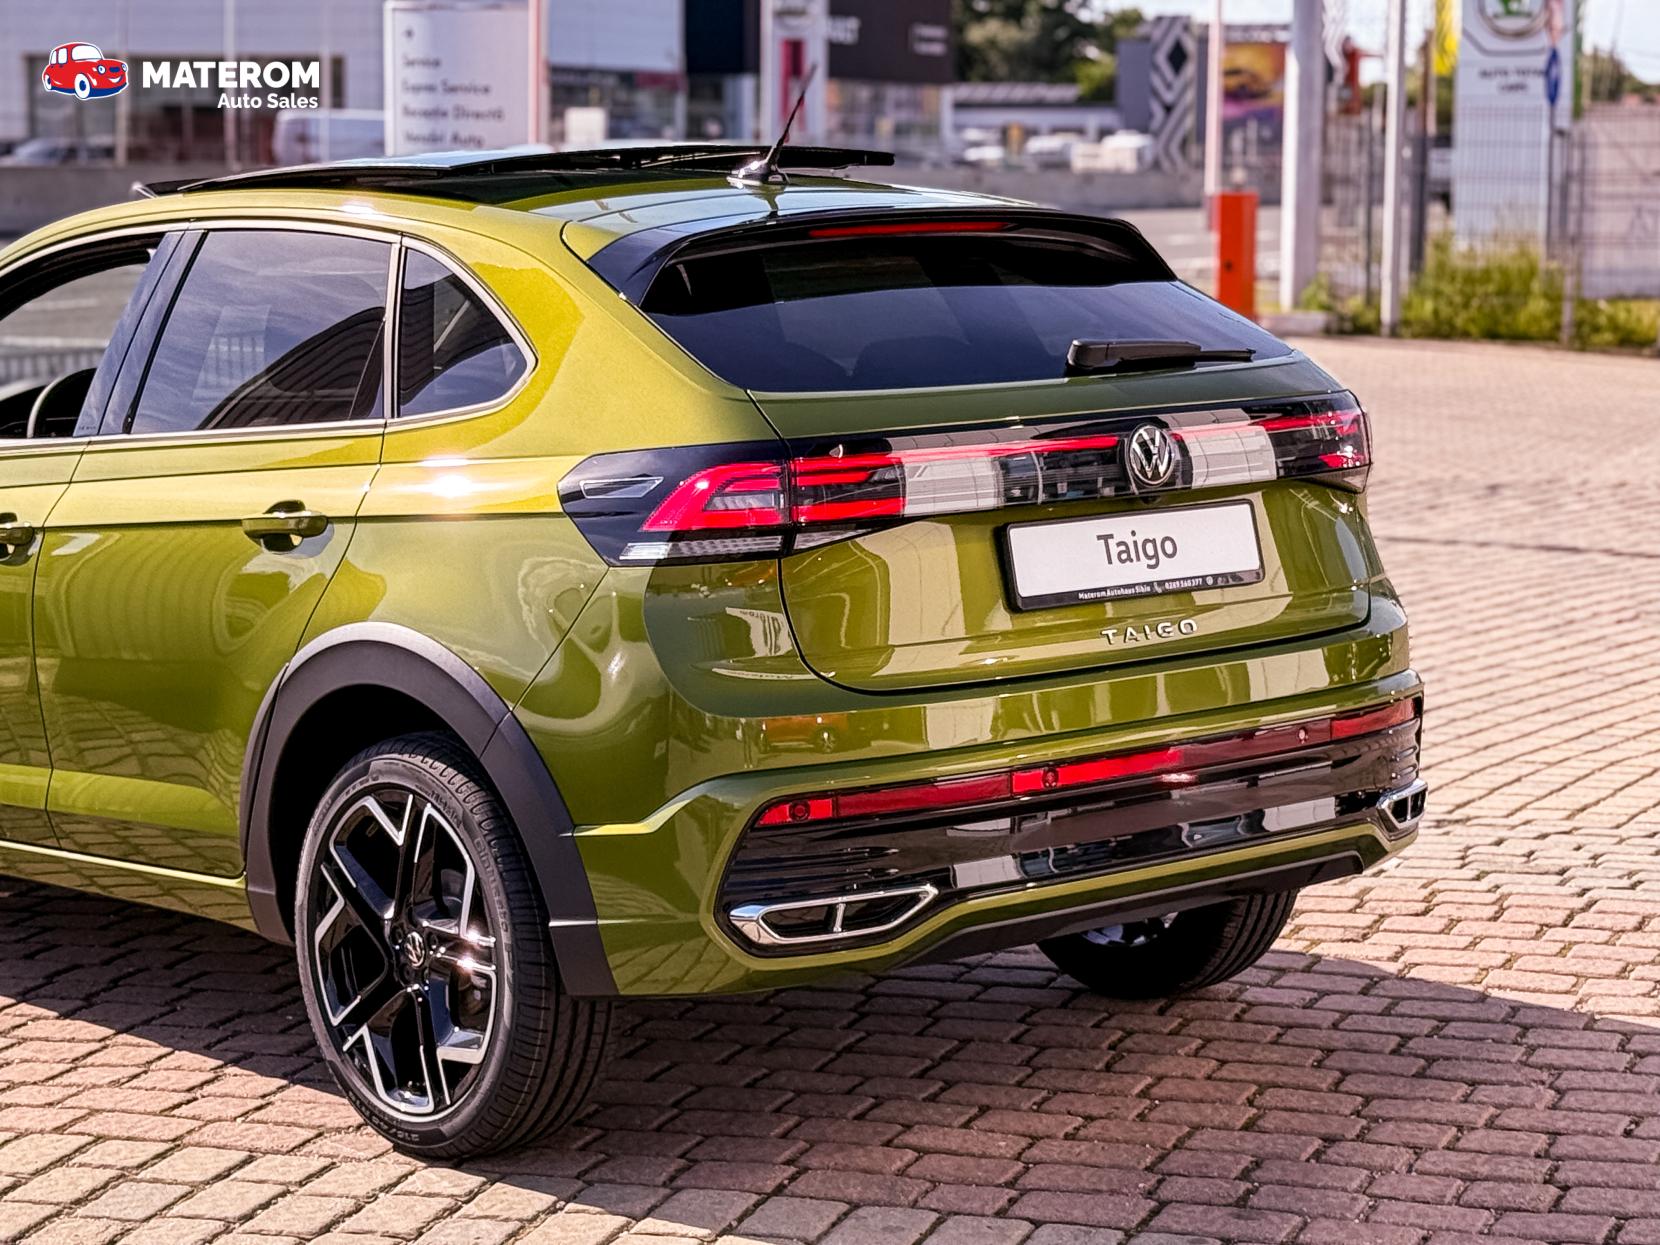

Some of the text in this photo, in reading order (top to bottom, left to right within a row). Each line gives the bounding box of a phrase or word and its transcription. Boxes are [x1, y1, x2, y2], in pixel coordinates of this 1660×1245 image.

[1096, 530, 1178, 570] Taigo
[1078, 590, 1106, 600] Materom
[1106, 586, 1135, 597] Autohaus
[1135, 584, 1151, 593] Sibiu
[1101, 619, 1198, 645] TAIGO
